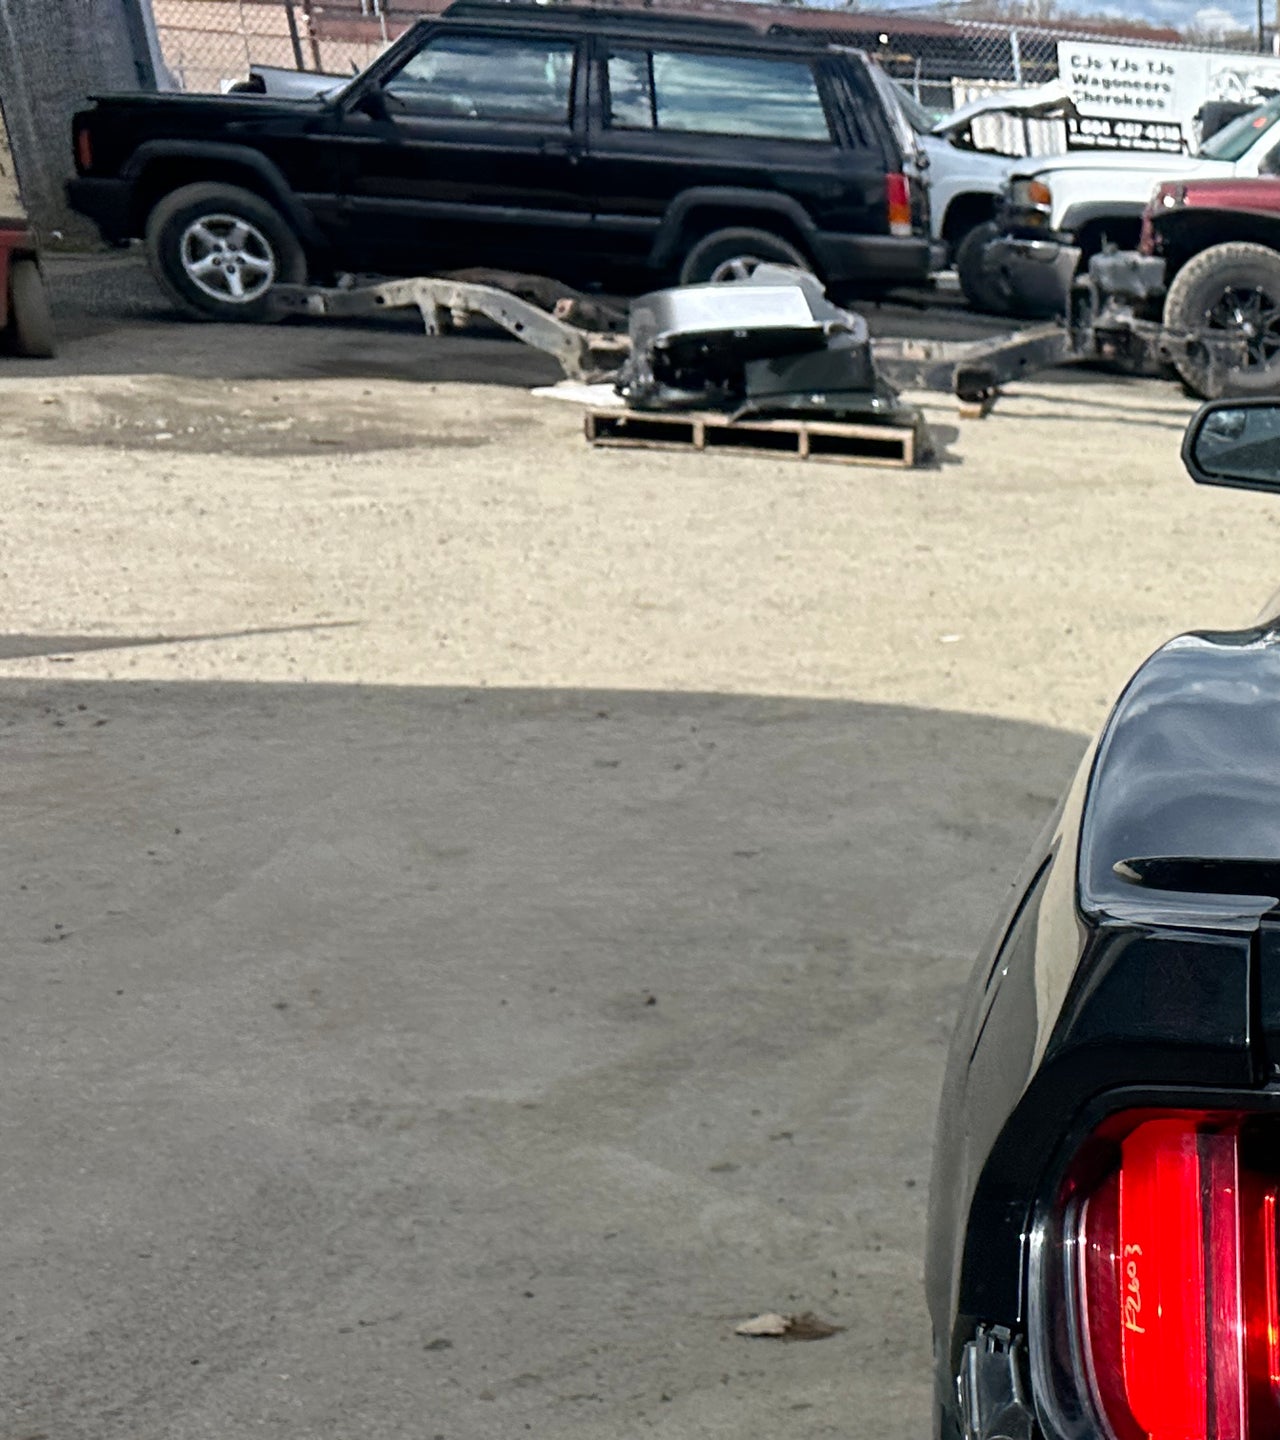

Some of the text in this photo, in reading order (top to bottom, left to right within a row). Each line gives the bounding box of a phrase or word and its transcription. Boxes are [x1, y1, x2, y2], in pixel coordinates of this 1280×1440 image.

[1071, 55, 1102, 69] CJs
[1110, 57, 1138, 72] YJs
[1072, 73, 1171, 93] Wagoneers
[1124, 1244, 1146, 1334] F2603
